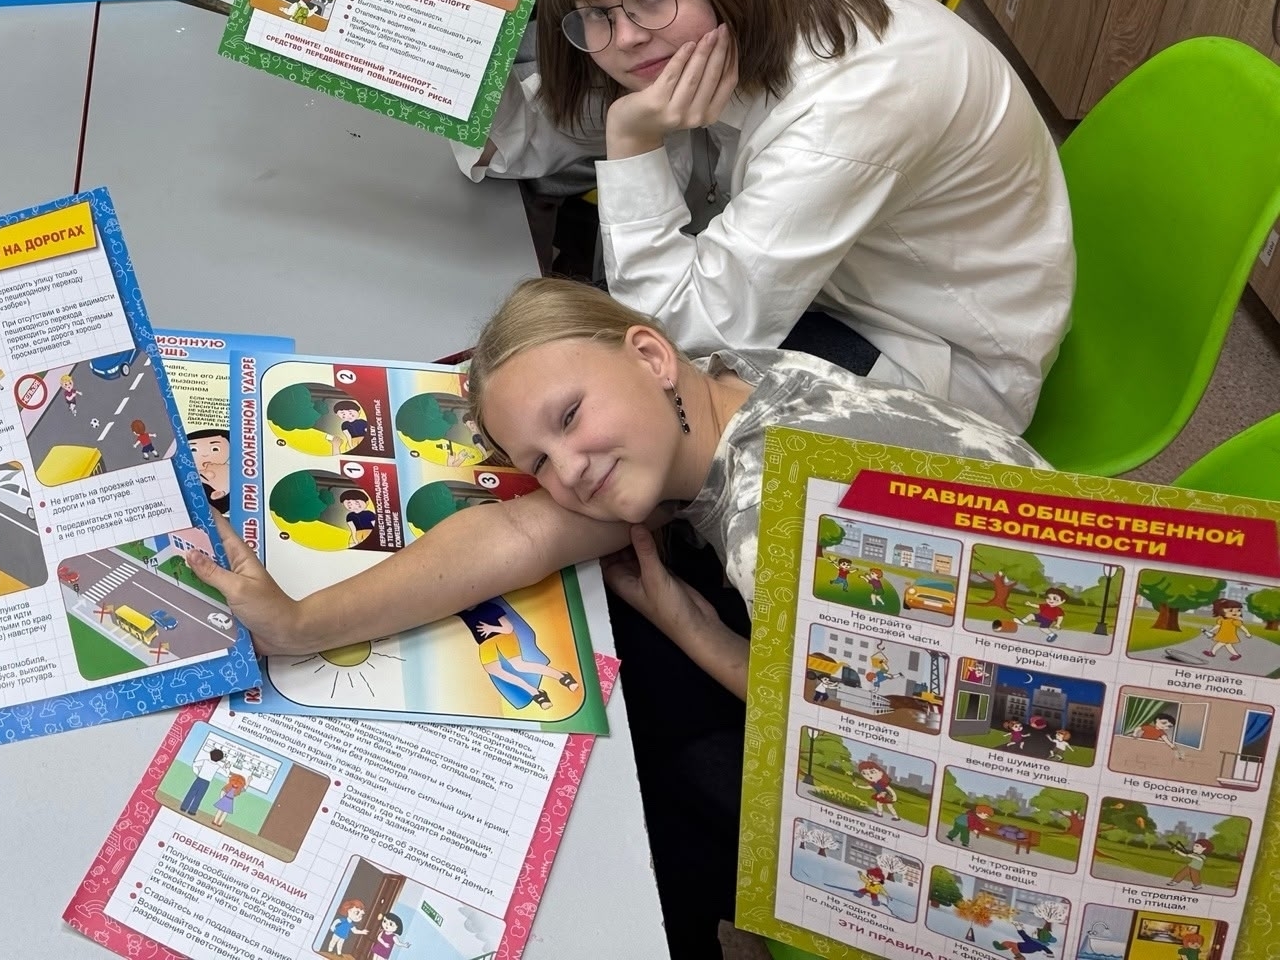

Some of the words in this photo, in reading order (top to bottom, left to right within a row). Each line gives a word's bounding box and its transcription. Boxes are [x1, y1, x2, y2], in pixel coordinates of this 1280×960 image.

[265, 34, 302, 51] СРЕДСТВО
[305, 48, 363, 73] ПЕРЕДВИЖЕНИЯ
[366, 70, 424, 95] ПОВЫШЕННОГО
[427, 91, 451, 105] РИСКА
[323, 46, 385, 72] ОБЩЕСТВЕННЫЙ
[388, 68, 431, 88] ТРАНСПОРТ
[2, 242, 22, 256] НА
[24, 224, 85, 252] ДОРОГАХ
[33, 275, 53, 287] улицу
[54, 268, 78, 279] только
[240, 357, 254, 395] УДАРЕ
[240, 399, 256, 476] СОЛНЕЧНОМ
[50, 498, 61, 506] Не
[62, 492, 87, 503] играть
[88, 488, 98, 496] на
[98, 478, 134, 493] проезжей
[134, 474, 156, 484] части
[240, 484, 256, 513] ПРИ
[889, 481, 1009, 513] ПРАВИЛА
[1017, 503, 1245, 546] ОБЩЕСТВЕННОЙ
[243, 517, 258, 550] ОЩЬ
[954, 512, 1166, 556] БЕЗОПАСНОСТИ
[818, 613, 849, 626] возле
[852, 621, 905, 638] проезжей
[850, 610, 865, 620] Не
[868, 616, 912, 630] играйте
[975, 636, 991, 647] Не
[994, 642, 1096, 665] переворачивайте
[1166, 679, 1201, 689] возле
[1174, 668, 1191, 678] Не
[1194, 673, 1242, 685] играйте
[345, 784, 403, 814] Ознакомьтесь
[412, 814, 445, 832] планом
[446, 828, 493, 853] эвакуации,
[171, 831, 229, 863] ПОВЕДЕНИЯ
[229, 858, 250, 873] ПРИ
[250, 868, 307, 900] ЭВАКУАЦИИ
[221, 843, 264, 868] ПРАВИЛА
